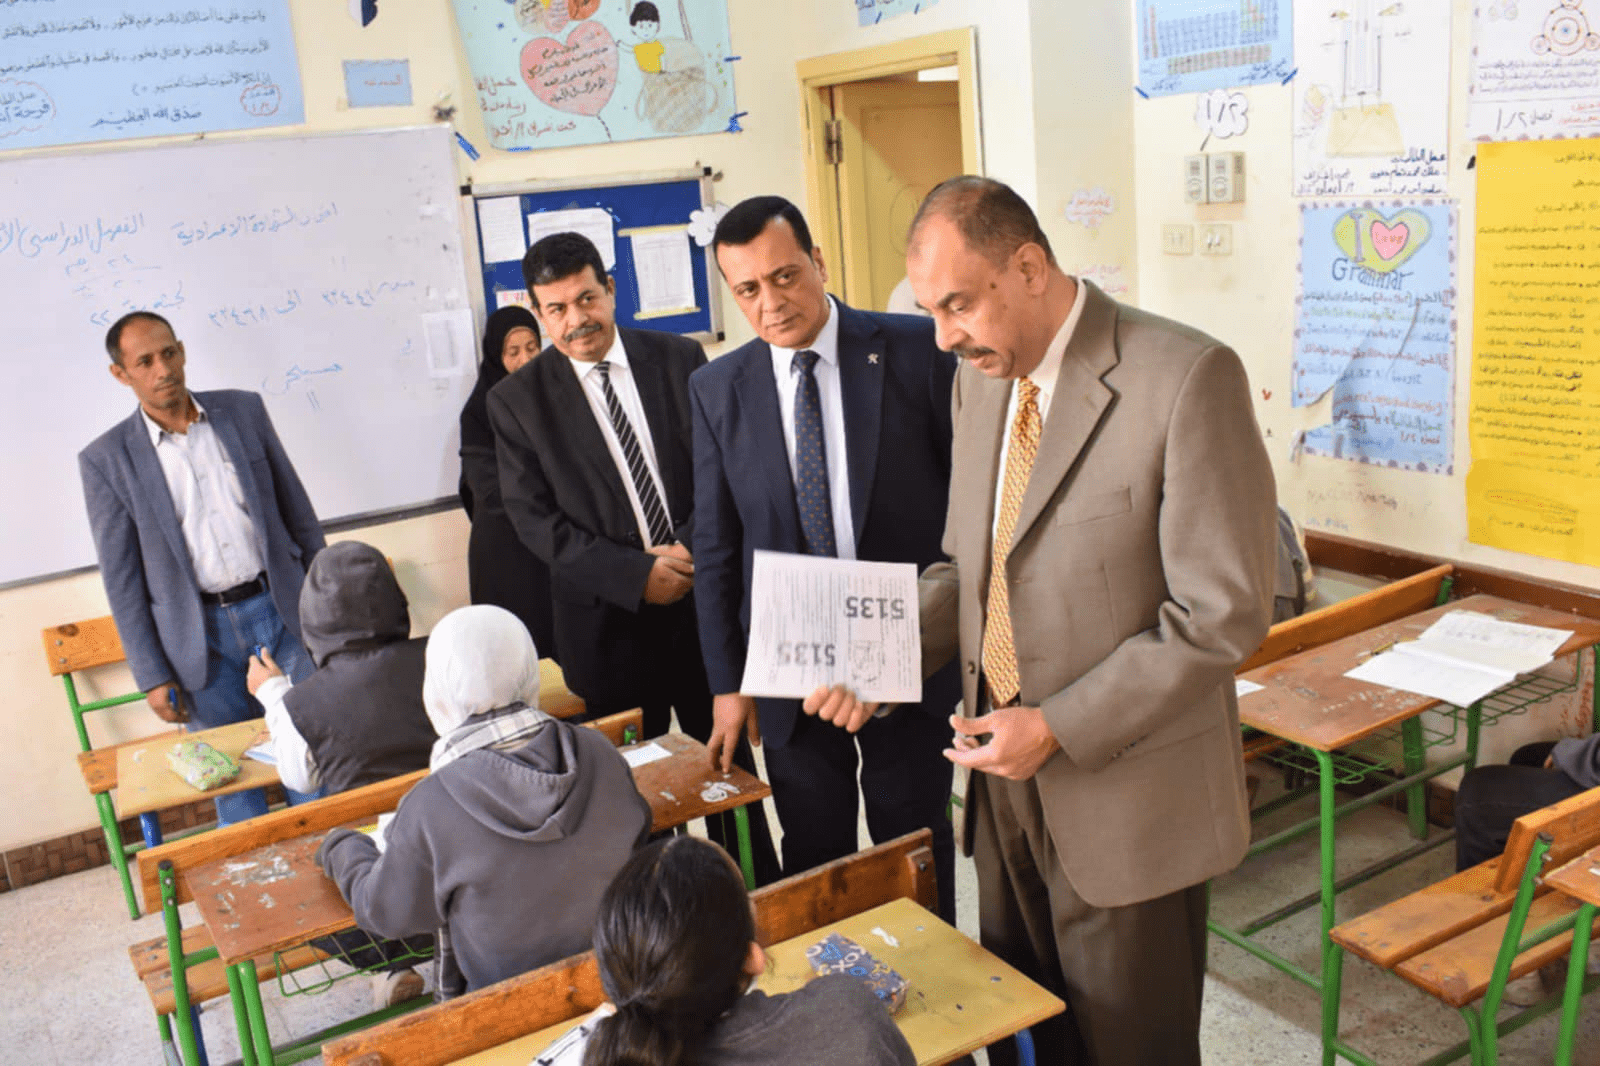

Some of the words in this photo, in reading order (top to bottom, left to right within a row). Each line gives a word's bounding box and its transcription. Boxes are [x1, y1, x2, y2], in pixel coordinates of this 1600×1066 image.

[89, 211, 146, 254] الفصل
[1350, 211, 1367, 264] I
[1332, 256, 1415, 291] Grammar
[845, 595, 905, 620] 5135
[776, 640, 836, 668] 5135
